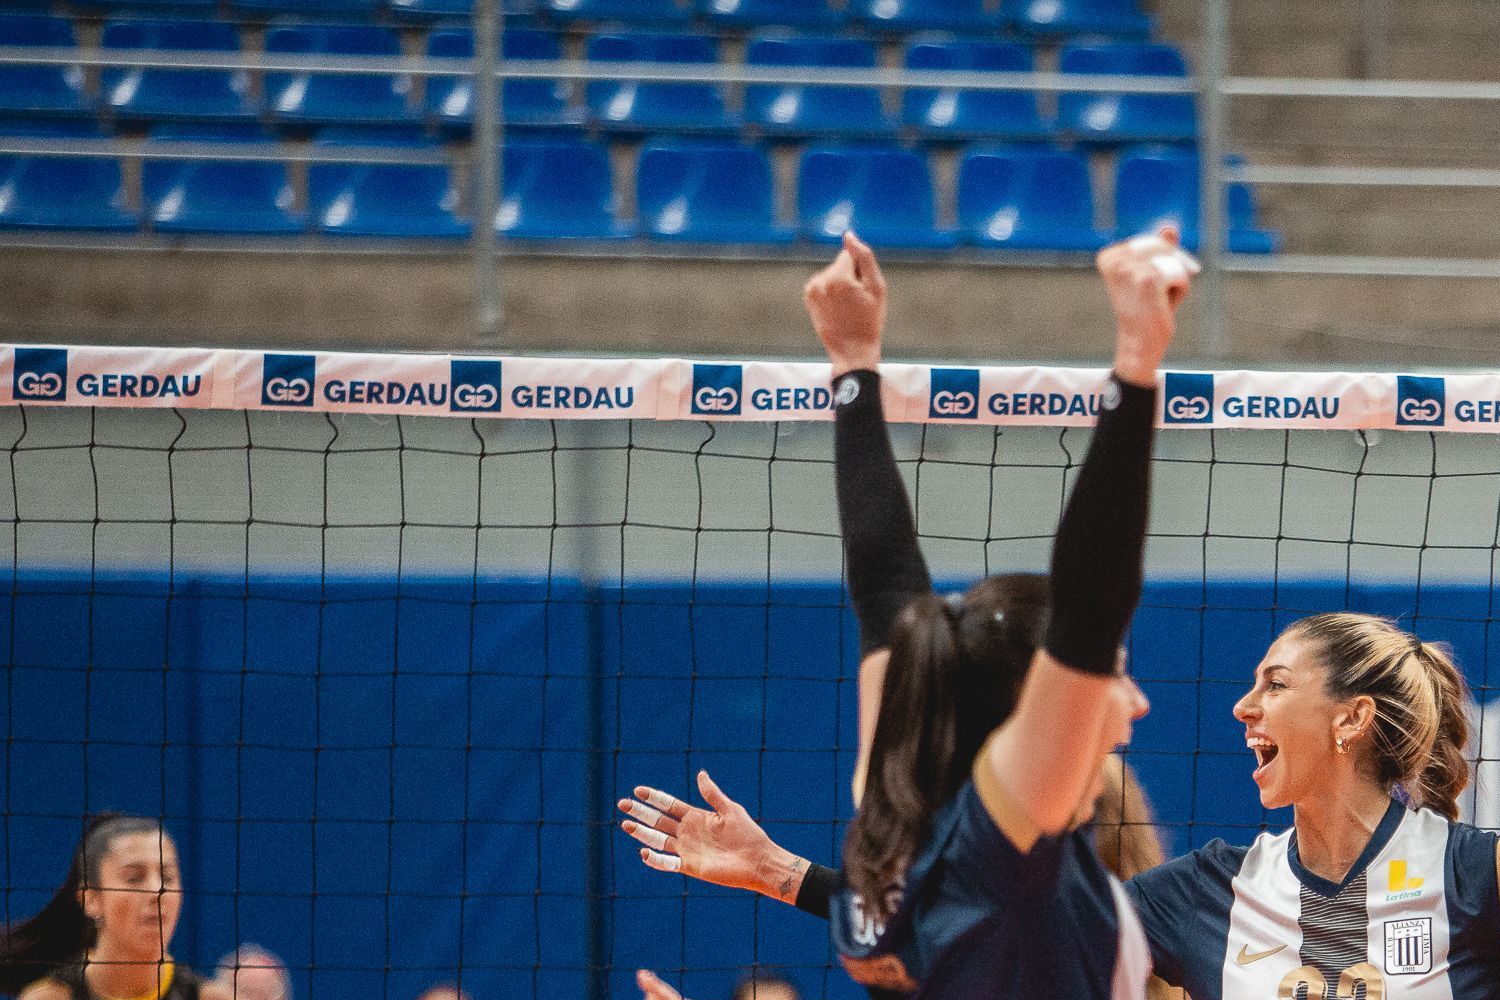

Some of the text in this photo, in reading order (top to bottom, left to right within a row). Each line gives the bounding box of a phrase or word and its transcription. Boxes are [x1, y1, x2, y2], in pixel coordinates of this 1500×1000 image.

[75, 373, 202, 398] GERDAU
[323, 379, 448, 406] GERDAU
[511, 385, 634, 409] GERDAU
[751, 387, 836, 412] GERD
[1222, 396, 1340, 419] GERDAU
[1391, 920, 1425, 929] ALIANZA
